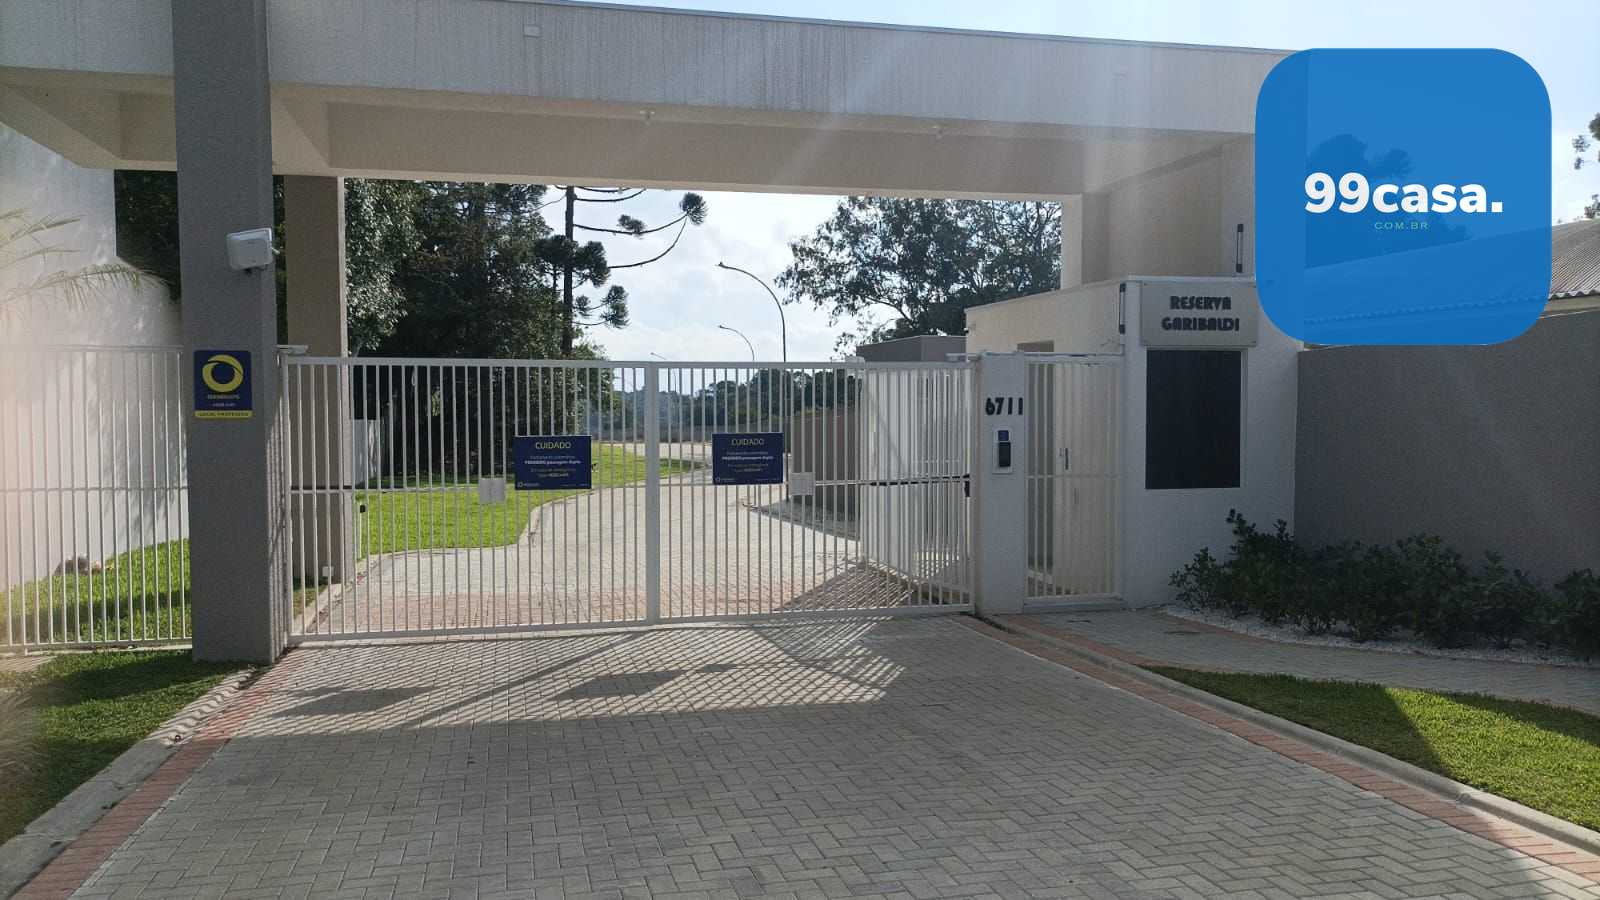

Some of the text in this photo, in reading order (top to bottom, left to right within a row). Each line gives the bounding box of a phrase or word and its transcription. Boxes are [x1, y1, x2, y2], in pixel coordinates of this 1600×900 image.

[1170, 295, 1232, 310] RESERVA
[1161, 317, 1240, 332] GARIBALDI
[985, 397, 1023, 416] 6711
[535, 441, 572, 450] CUIDADO
[731, 438, 765, 446] CUIDADO
